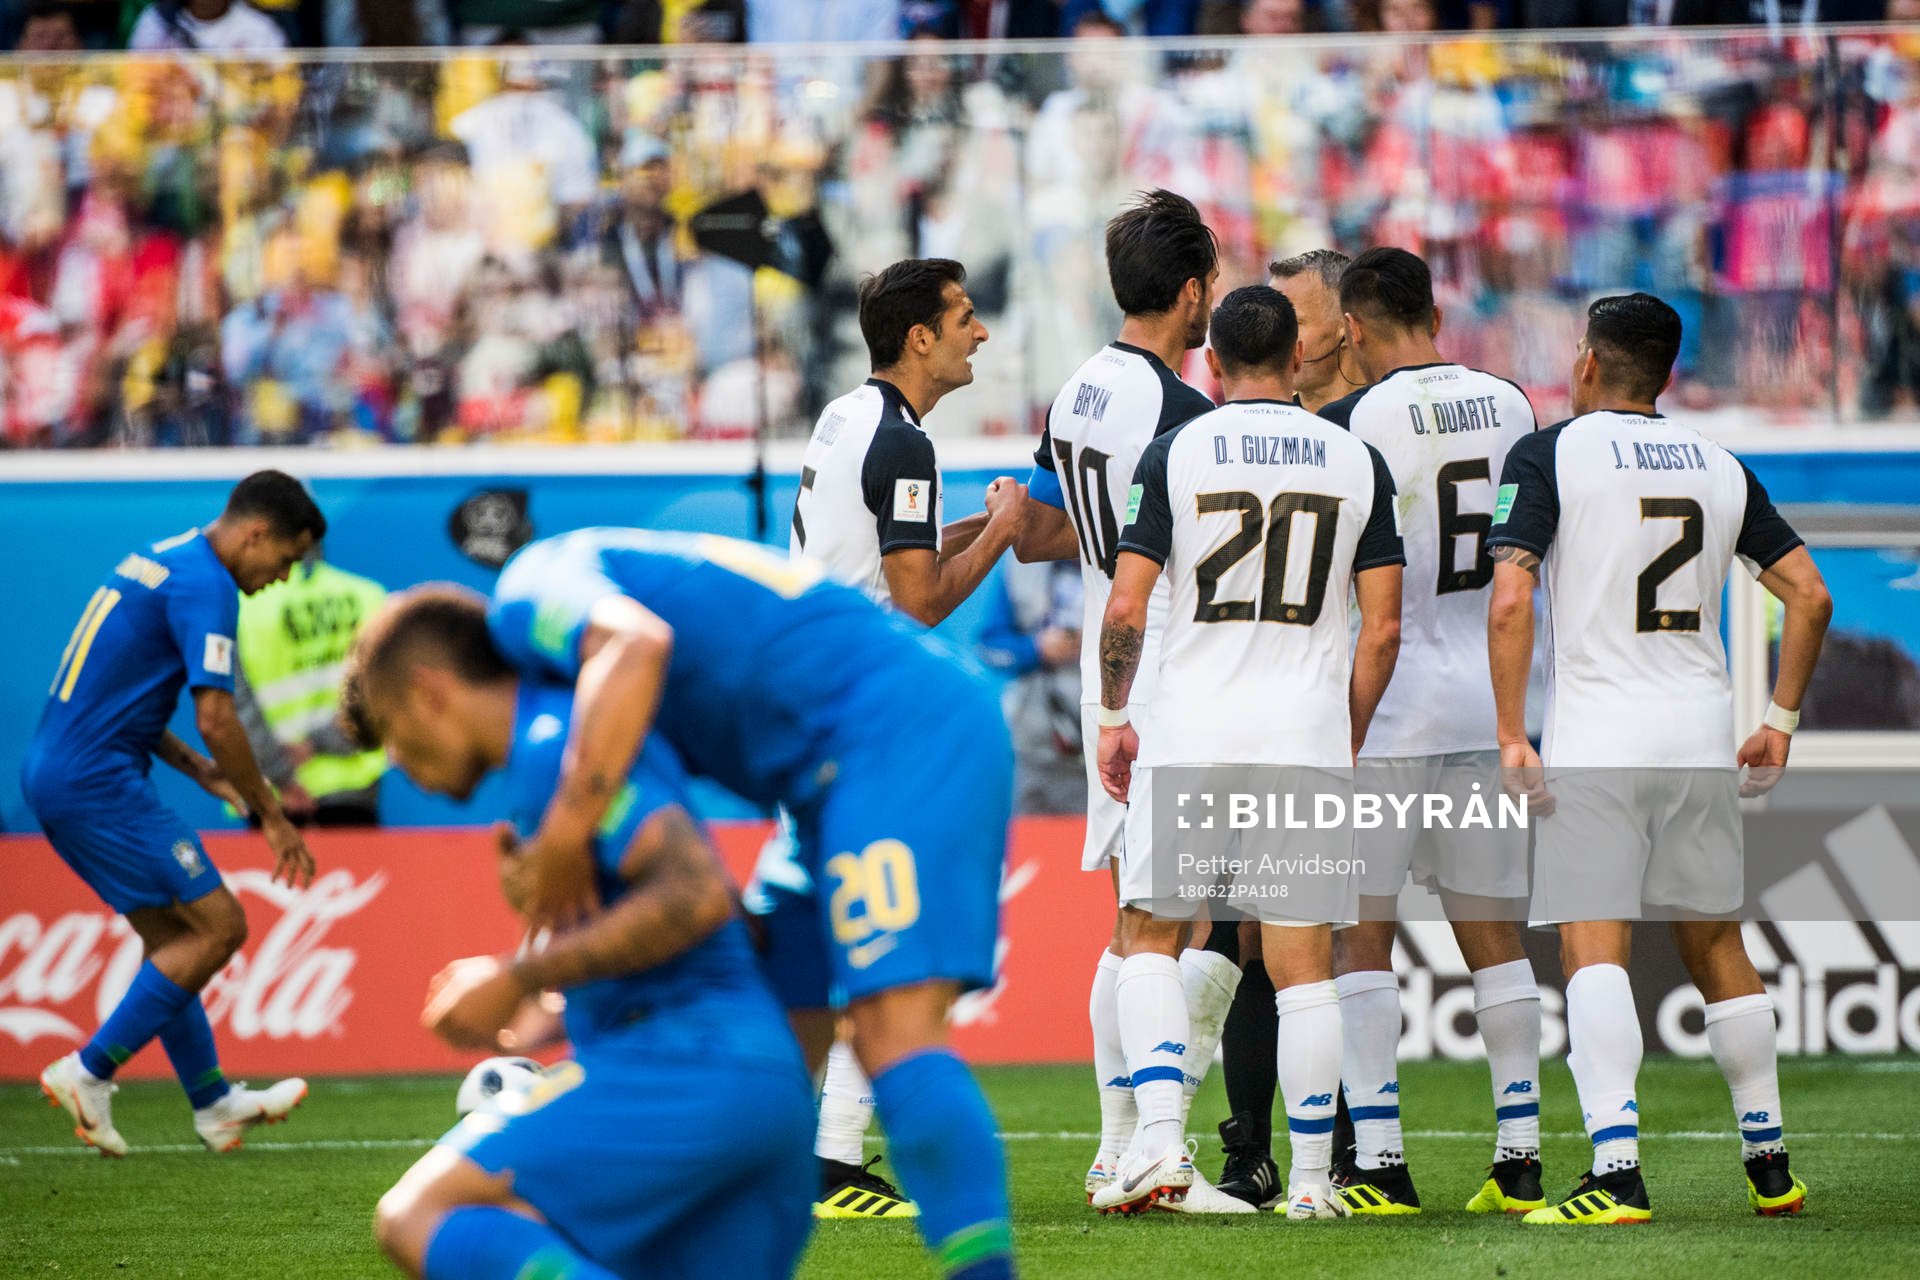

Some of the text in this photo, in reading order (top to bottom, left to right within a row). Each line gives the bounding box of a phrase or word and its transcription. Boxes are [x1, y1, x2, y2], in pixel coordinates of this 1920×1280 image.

[1073, 382, 1112, 422] BRYAN
[1418, 375, 1443, 384] COSTA
[1432, 396, 1501, 434] DUARTE
[1214, 434, 1326, 468] D. GUZMAN
[1611, 440, 1707, 471] J. ACOSTA
[1052, 437, 1121, 580] 10
[1193, 490, 1347, 627] 20
[1436, 457, 1495, 596] 6
[1635, 496, 1704, 634] 2
[49, 585, 121, 703] 11
[825, 838, 920, 944] 20
